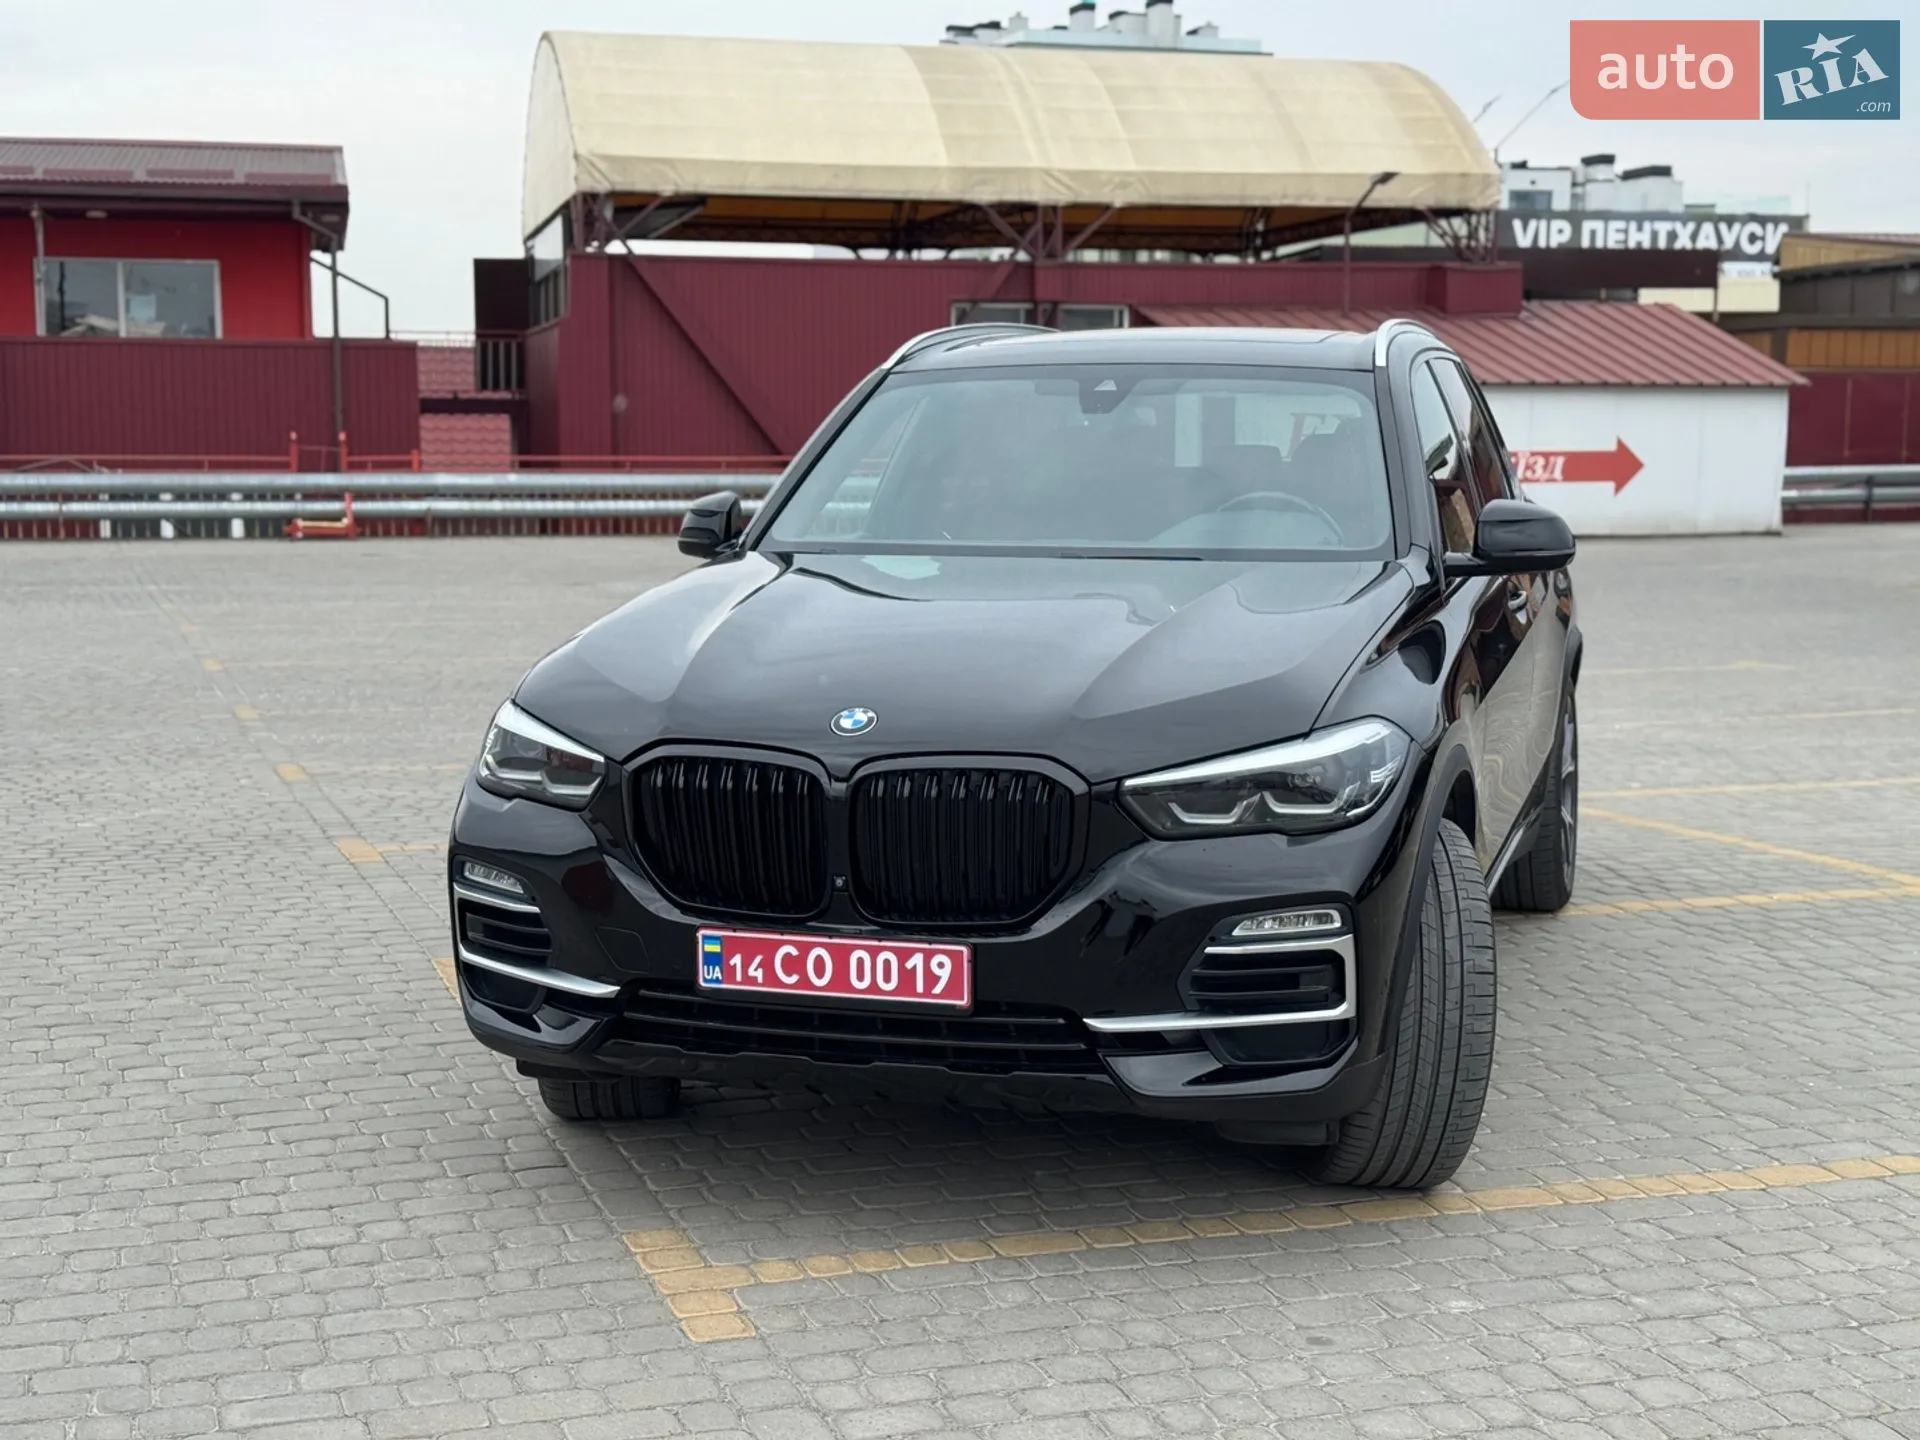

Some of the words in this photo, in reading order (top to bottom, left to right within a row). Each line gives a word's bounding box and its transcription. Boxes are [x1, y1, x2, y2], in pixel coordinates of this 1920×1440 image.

[1512, 218, 1572, 249] VIP
[1510, 452, 1566, 482] ЇЗД
[704, 965, 722, 980] UA
[729, 953, 764, 983] 14
[774, 944, 833, 987] CO
[849, 949, 952, 994] 0019
